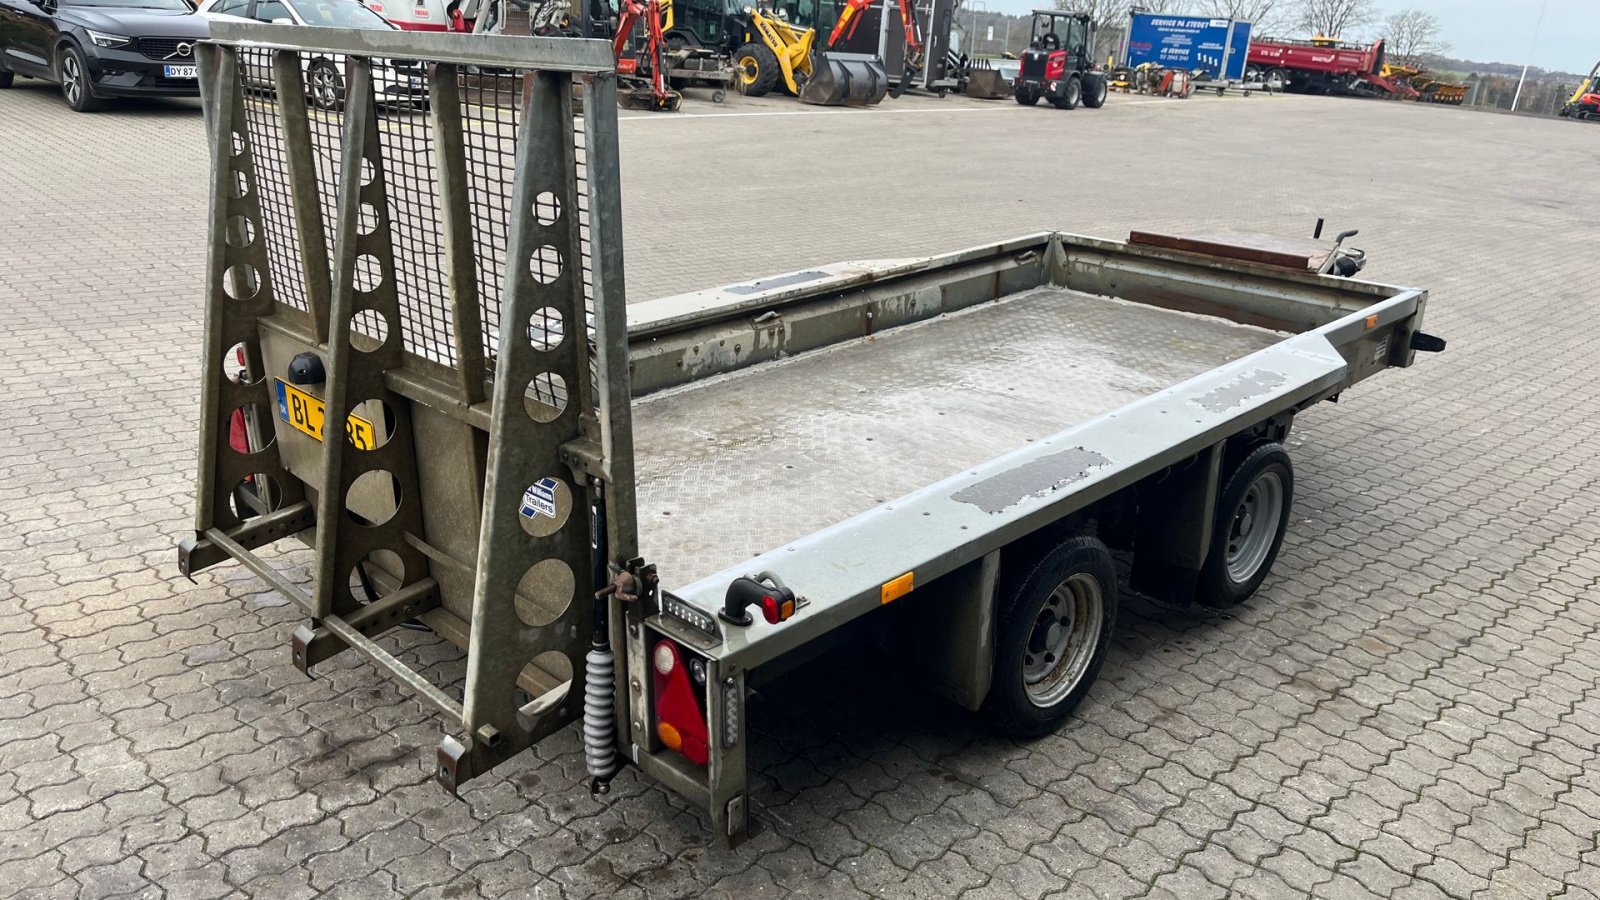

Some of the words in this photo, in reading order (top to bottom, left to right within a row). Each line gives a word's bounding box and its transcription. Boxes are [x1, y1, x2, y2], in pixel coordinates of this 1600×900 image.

[1151, 18, 1177, 28] SERVICE
[760, 21, 778, 48] KOMATSU
[170, 67, 182, 76] DY
[183, 67, 193, 76] 87
[524, 493, 554, 514] Trailers
